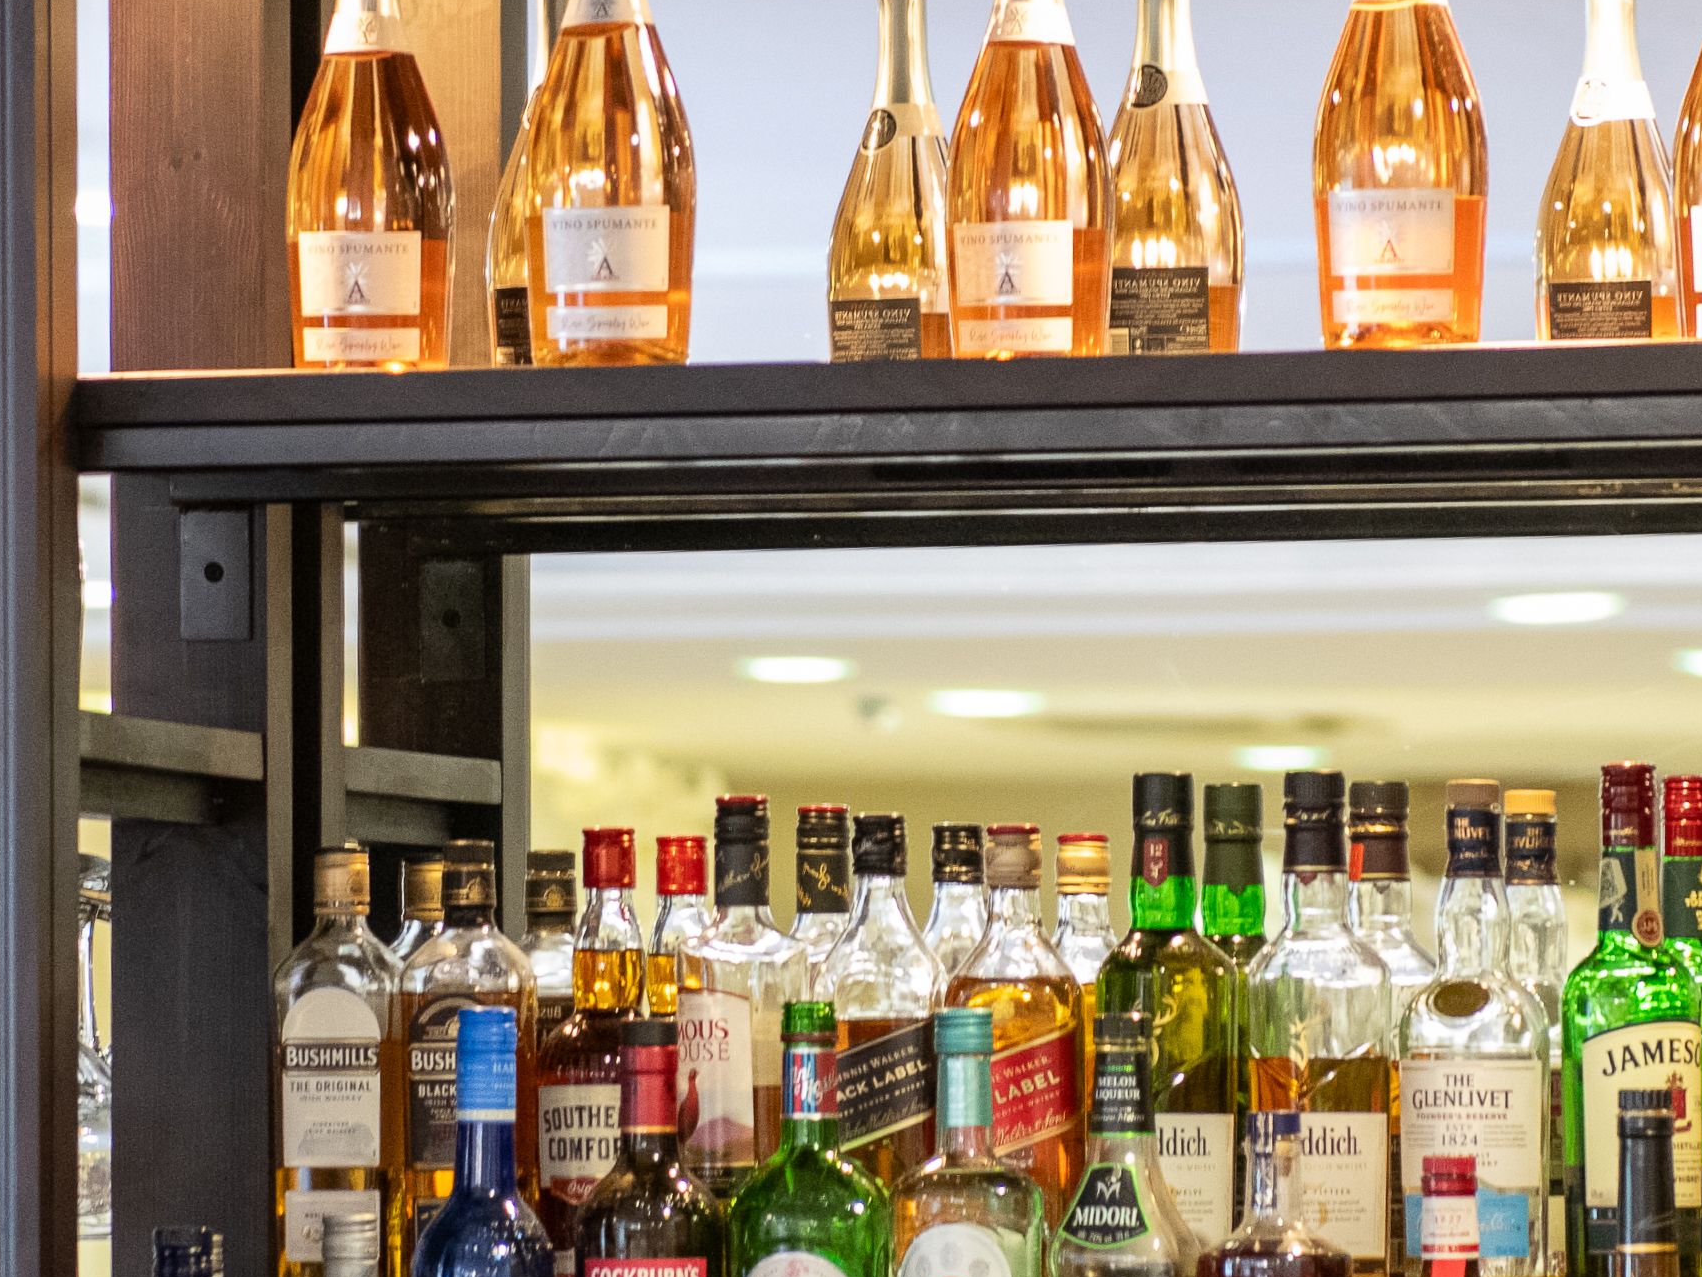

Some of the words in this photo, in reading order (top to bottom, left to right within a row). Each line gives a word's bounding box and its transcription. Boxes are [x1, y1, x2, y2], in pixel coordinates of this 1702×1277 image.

[1371, 200, 1444, 212] SPUMANTE
[585, 218, 658, 230] SPUMANTE
[339, 243, 409, 256] SPUMANTE
[286, 1046, 378, 1067] BUSHMILLS
[873, 1059, 928, 1088] LABEL
[290, 1080, 309, 1092] THE
[316, 1080, 372, 1092] ORIGINAL
[994, 1070, 1060, 1104] LABEL
[1443, 1074, 1474, 1088] THE
[1413, 1089, 1513, 1109] GLENLIVET
[1441, 1133, 1478, 1146] 1824
[1073, 1206, 1137, 1227] MIDORI
